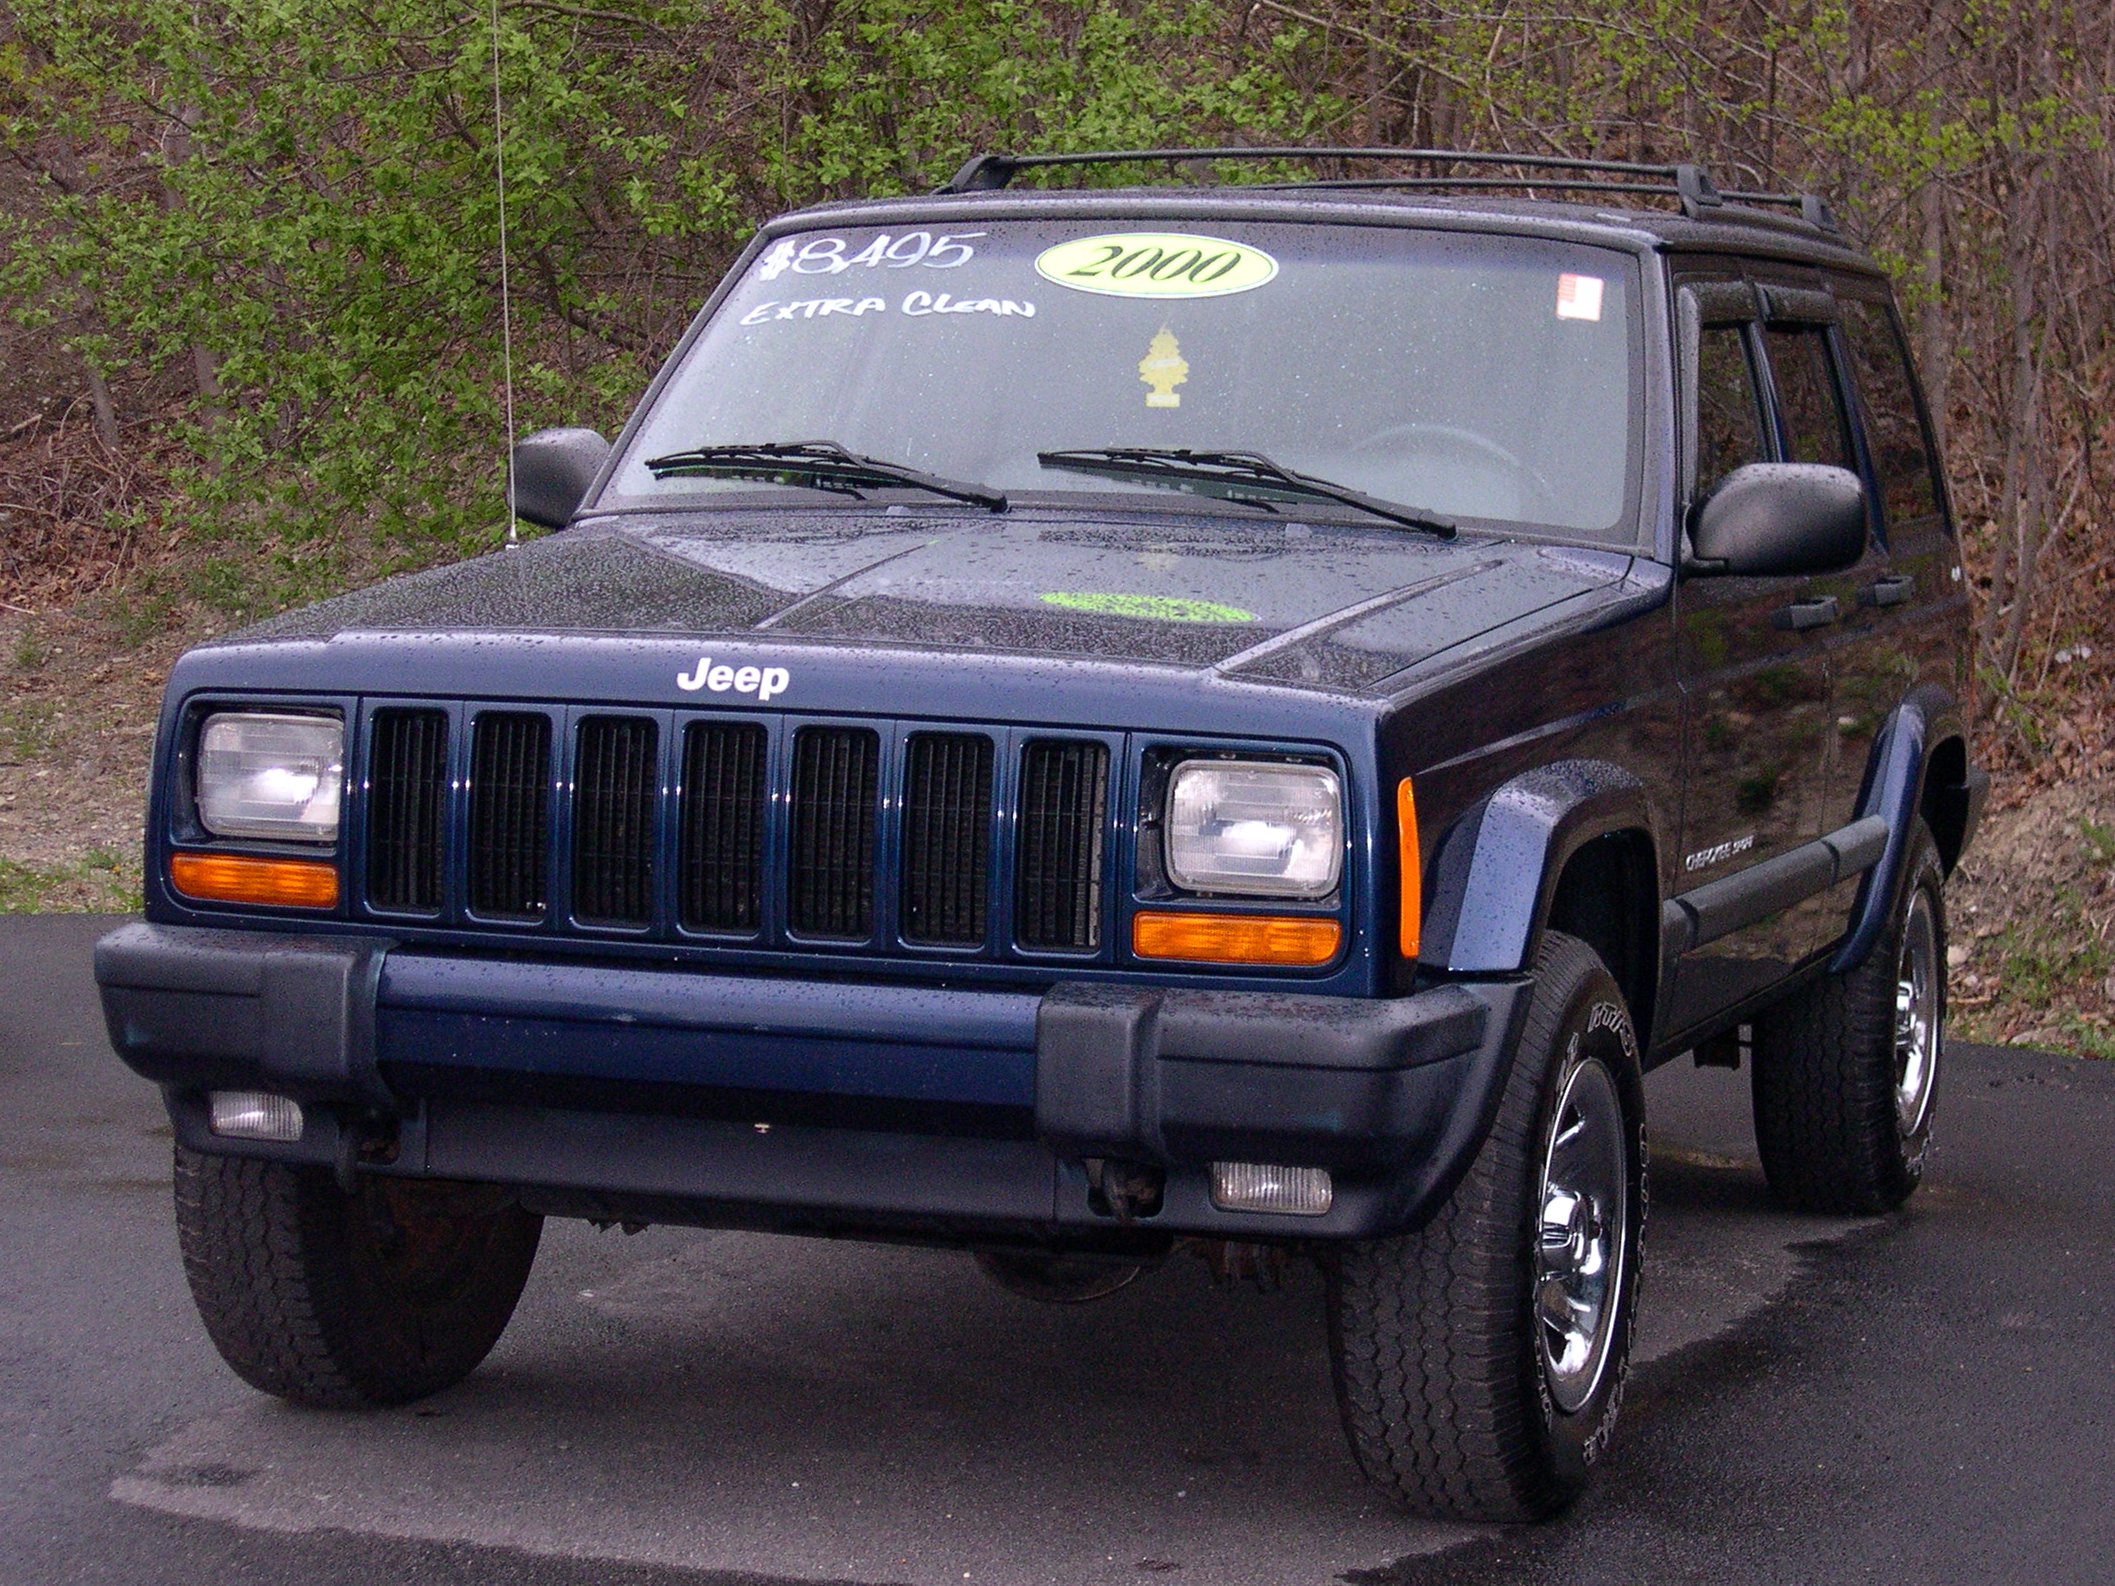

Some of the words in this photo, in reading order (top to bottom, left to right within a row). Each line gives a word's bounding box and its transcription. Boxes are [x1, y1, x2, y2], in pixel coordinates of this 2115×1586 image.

[1066, 246, 1242, 283] 2000
[740, 298, 886, 325] EXTRA
[676, 657, 790, 701] Jeep
